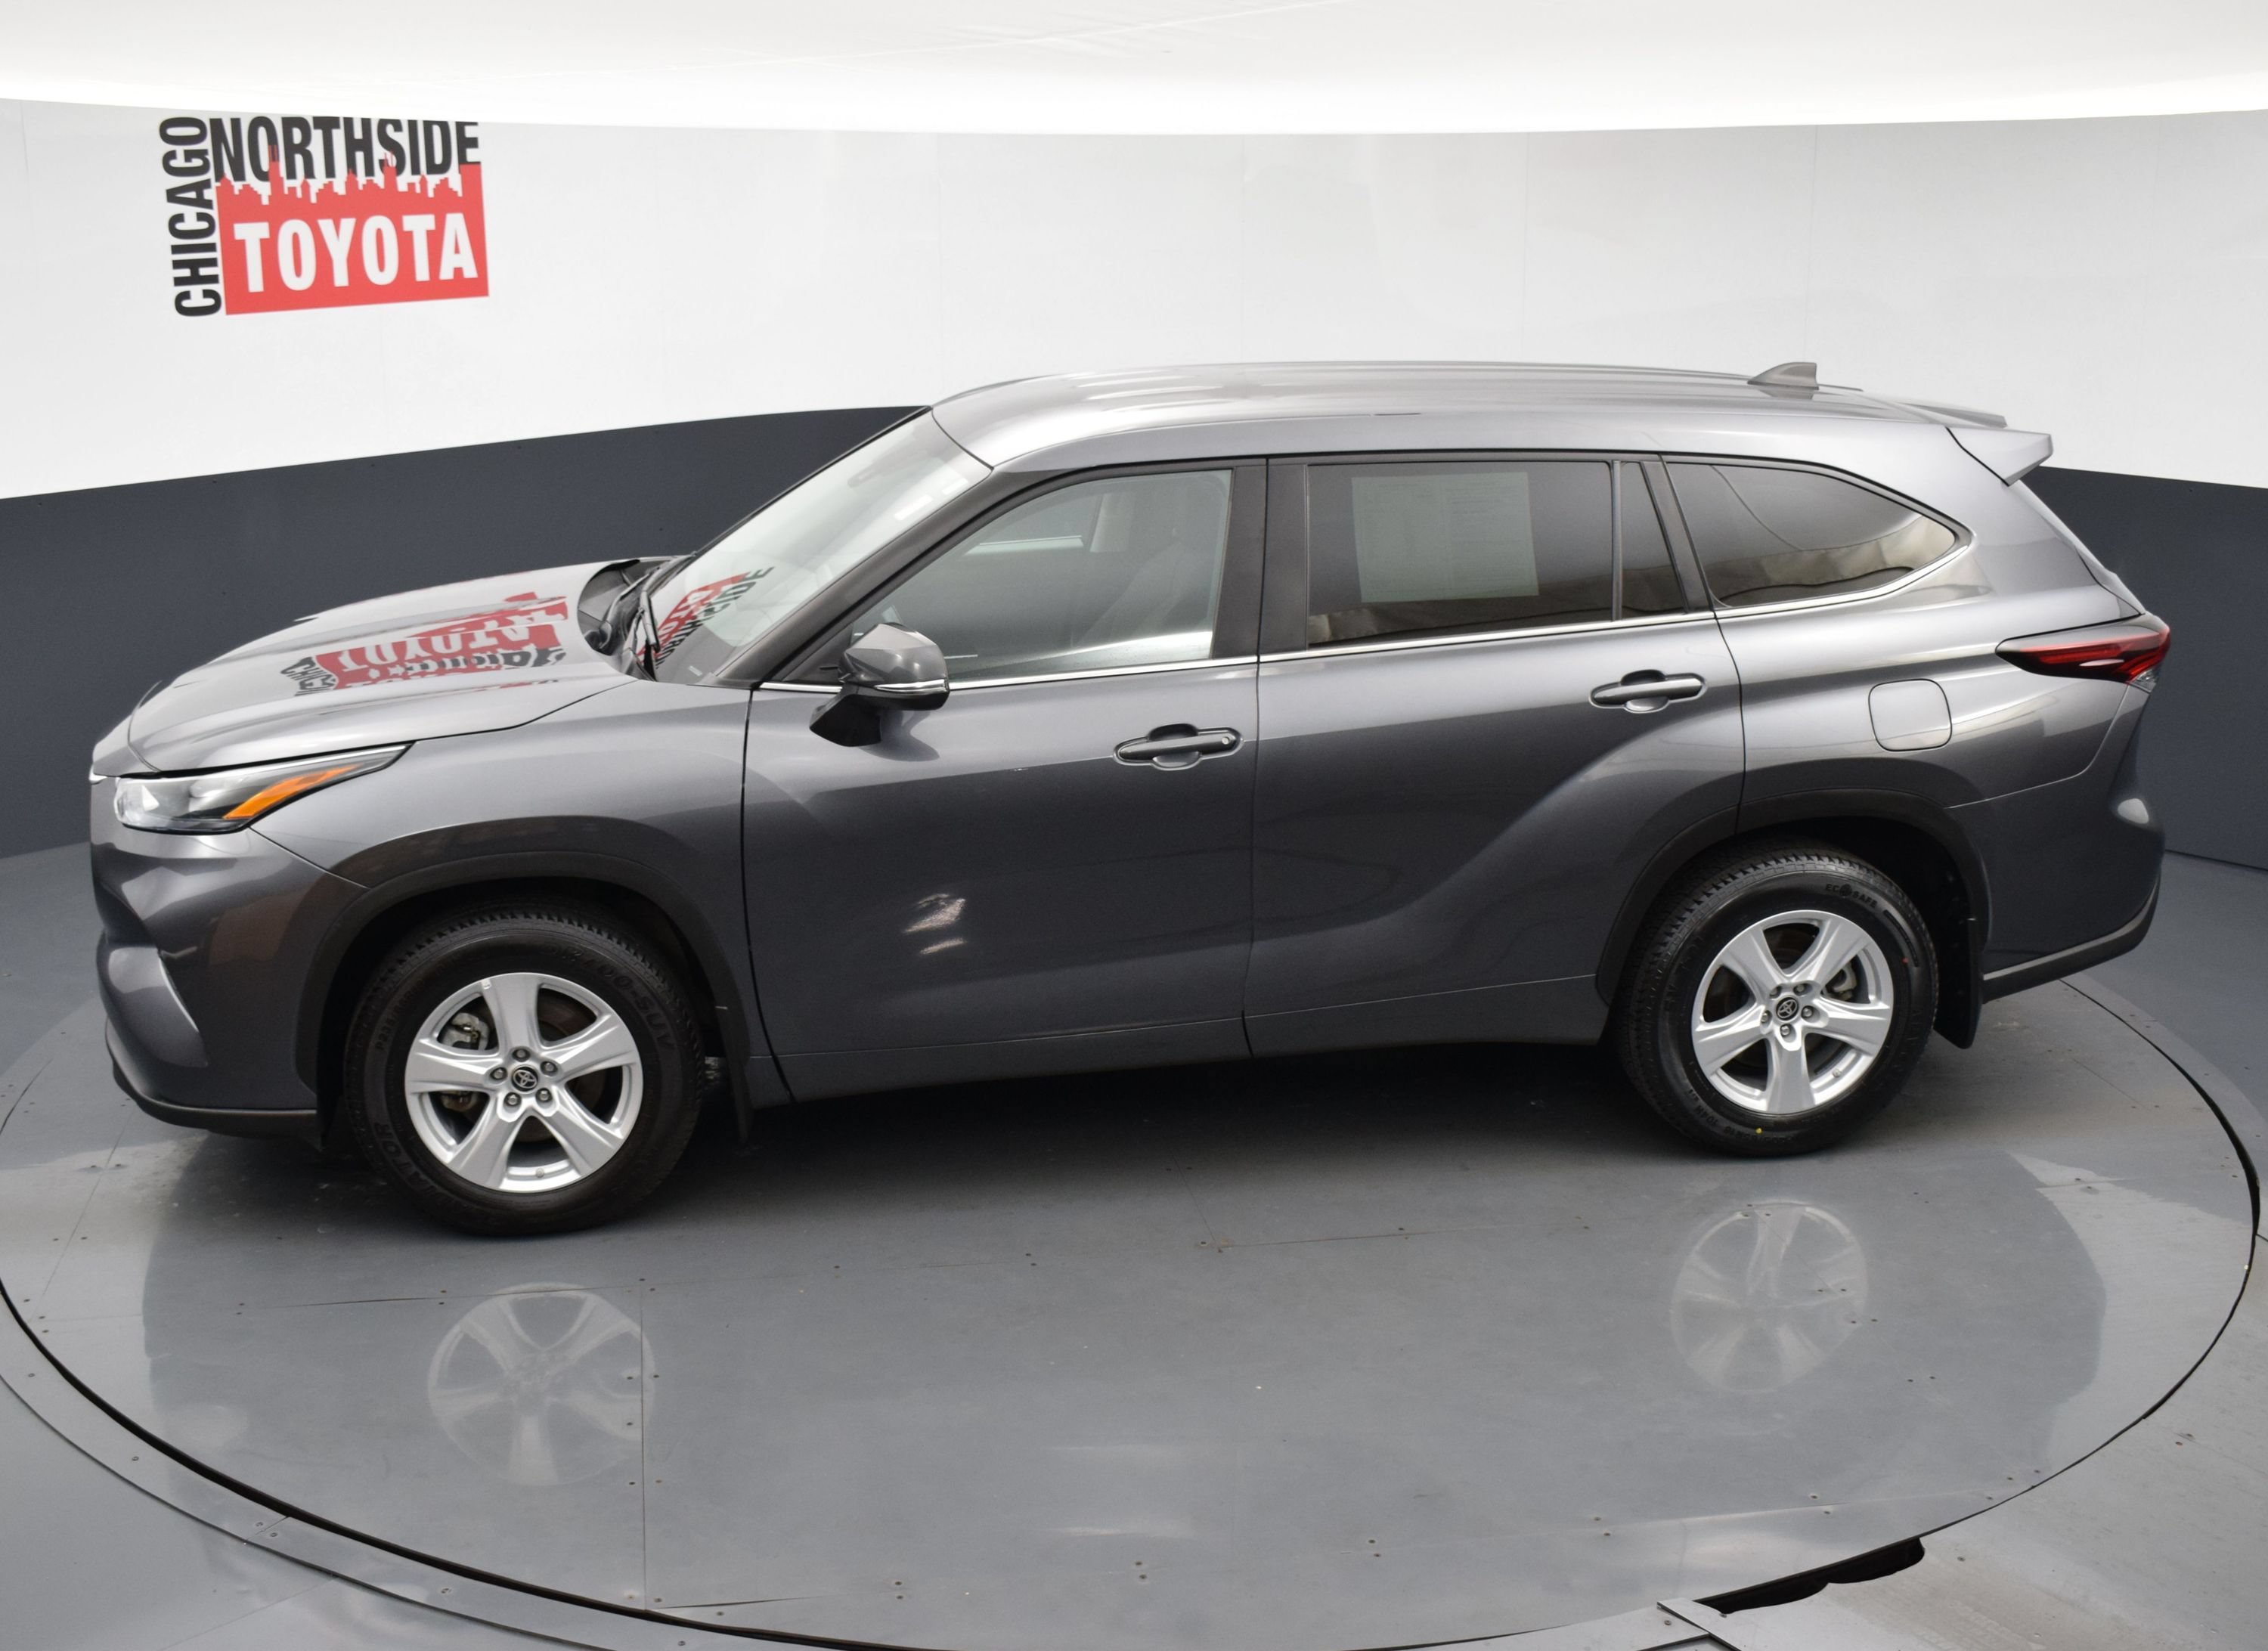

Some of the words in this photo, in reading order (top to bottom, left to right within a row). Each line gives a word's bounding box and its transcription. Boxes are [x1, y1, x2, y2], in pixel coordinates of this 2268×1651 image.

[209, 116, 482, 182] NORTHSIDE
[159, 116, 222, 317] CHICAGO
[234, 212, 478, 293] TOYOTA
